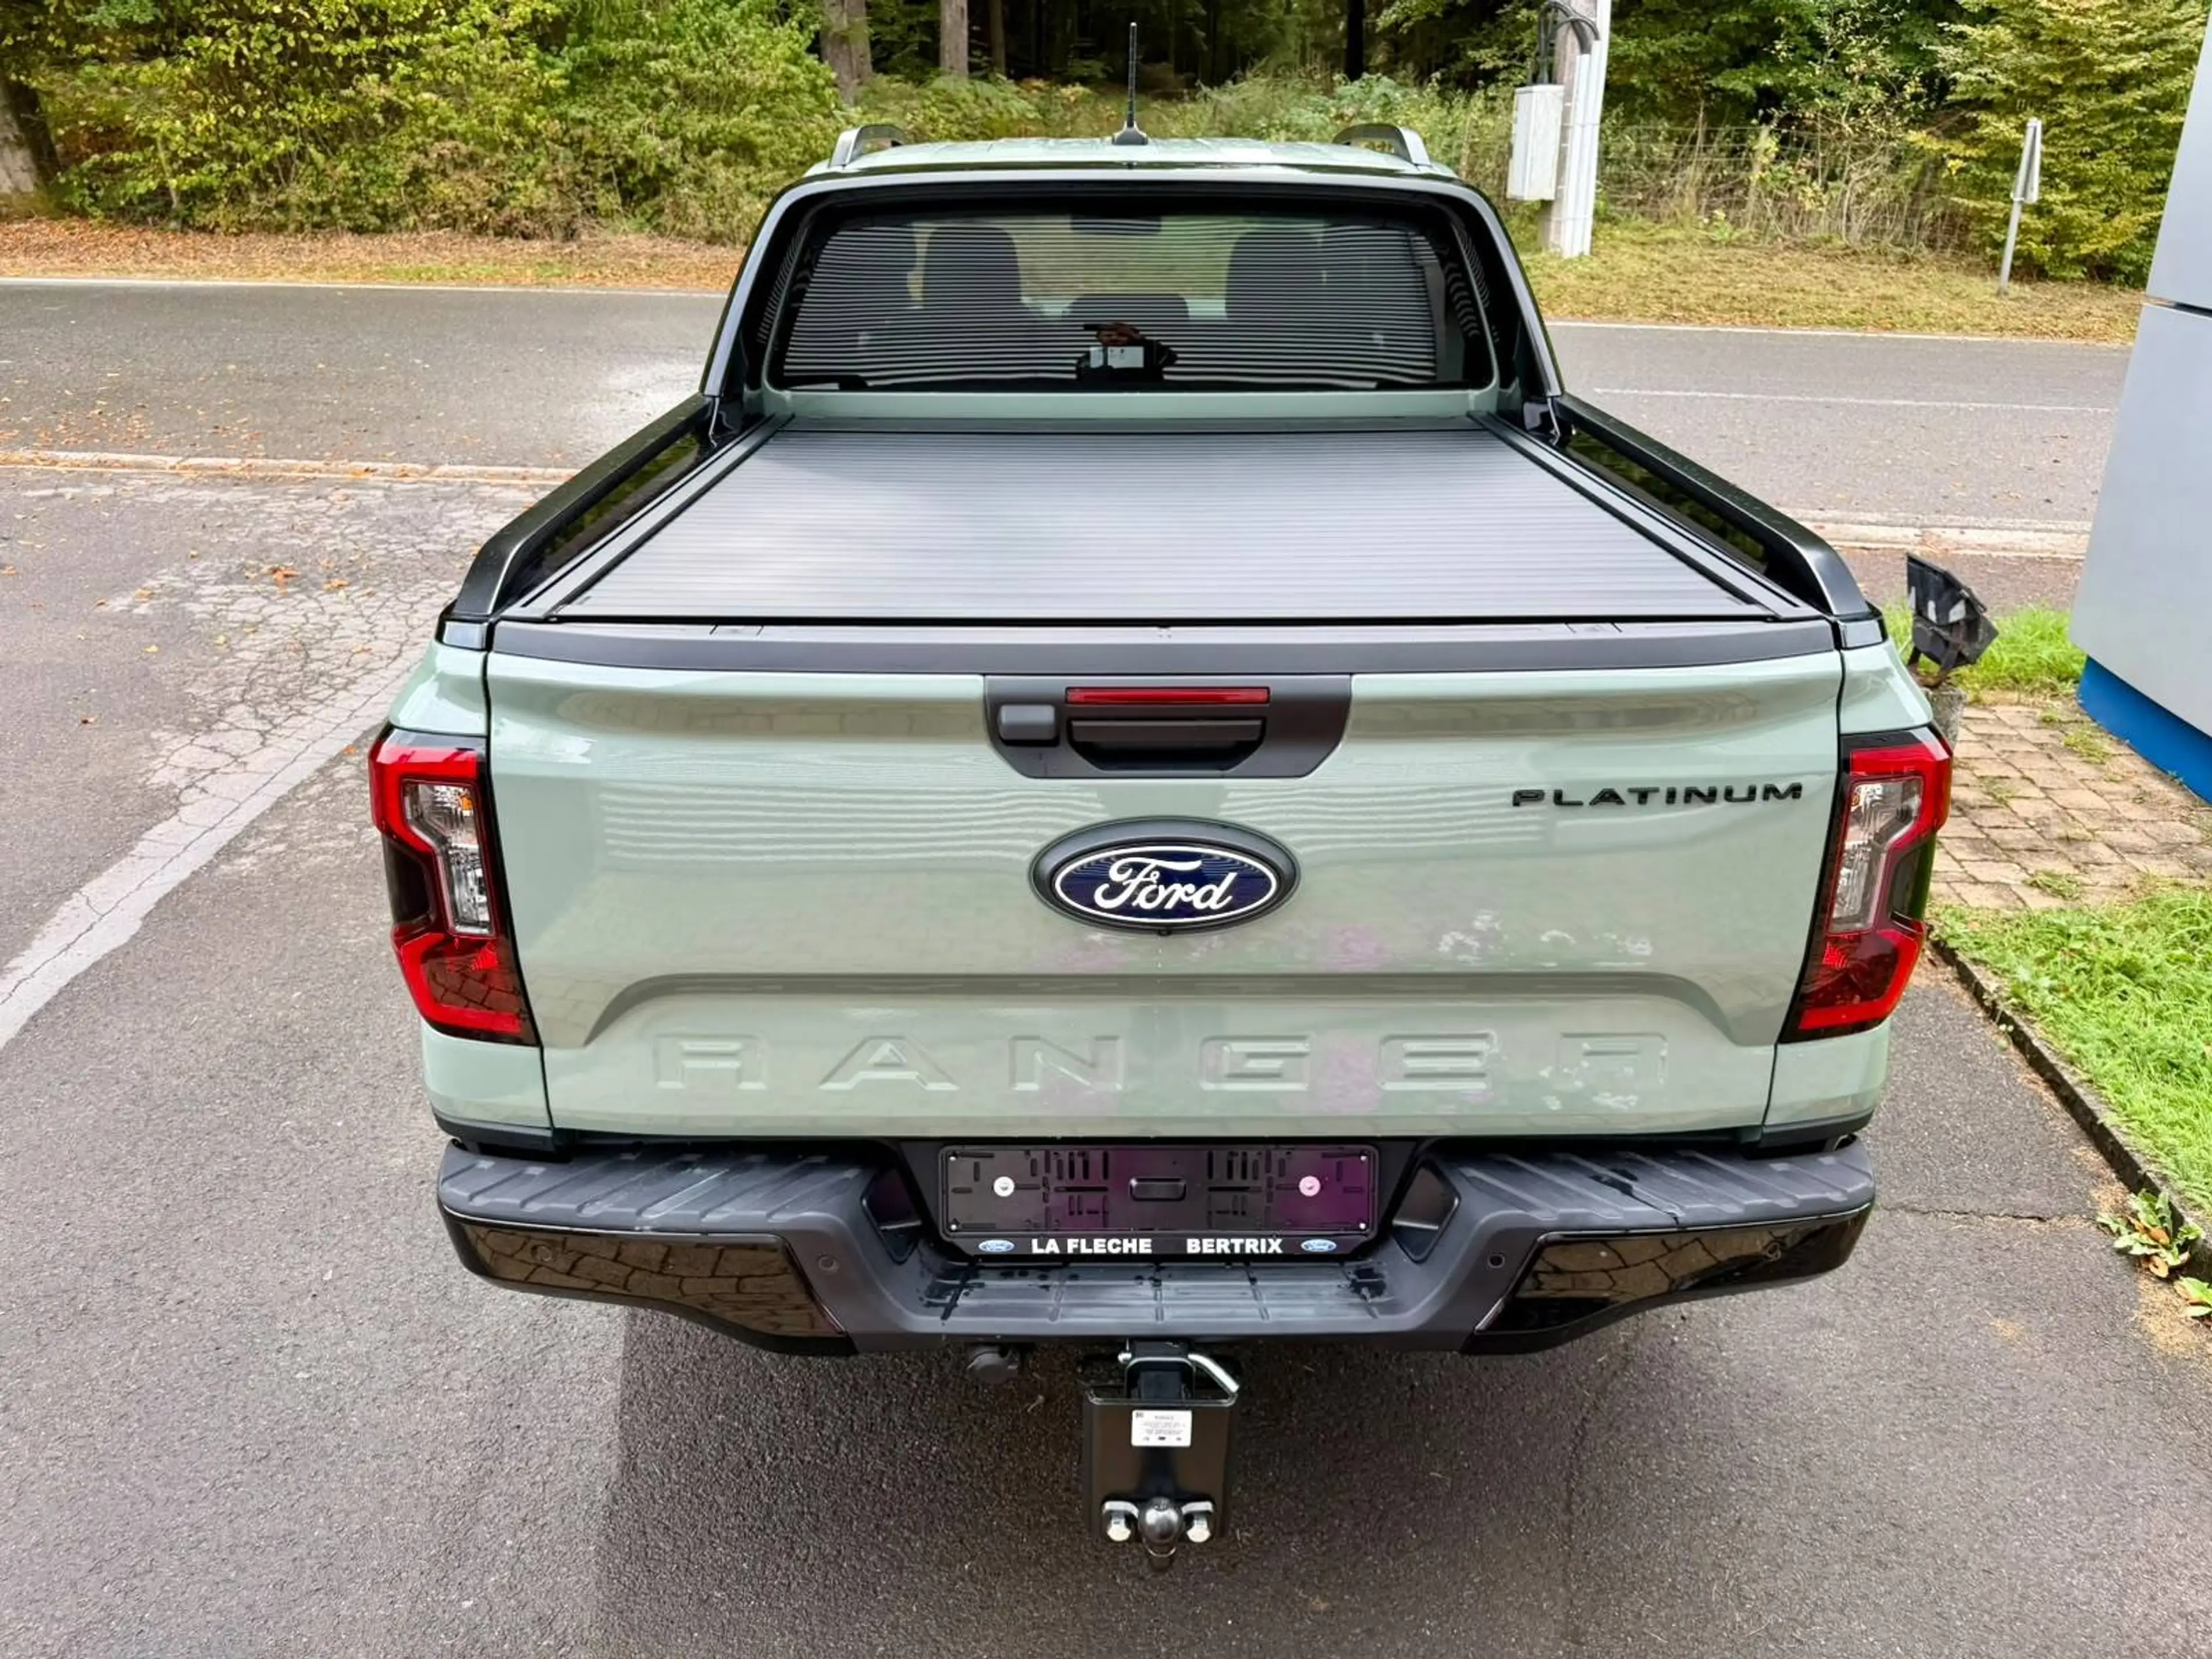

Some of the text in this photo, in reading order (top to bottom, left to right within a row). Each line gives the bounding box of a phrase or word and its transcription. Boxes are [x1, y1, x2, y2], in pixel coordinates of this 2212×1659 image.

[1512, 782, 1802, 806] PLATINUM
[1094, 857, 1237, 910] Ford
[652, 1031, 1670, 1091] RANGER
[1031, 1238, 1060, 1254] LA
[1067, 1238, 1152, 1254] FLECHE
[1187, 1238, 1283, 1254] BERTRIX
